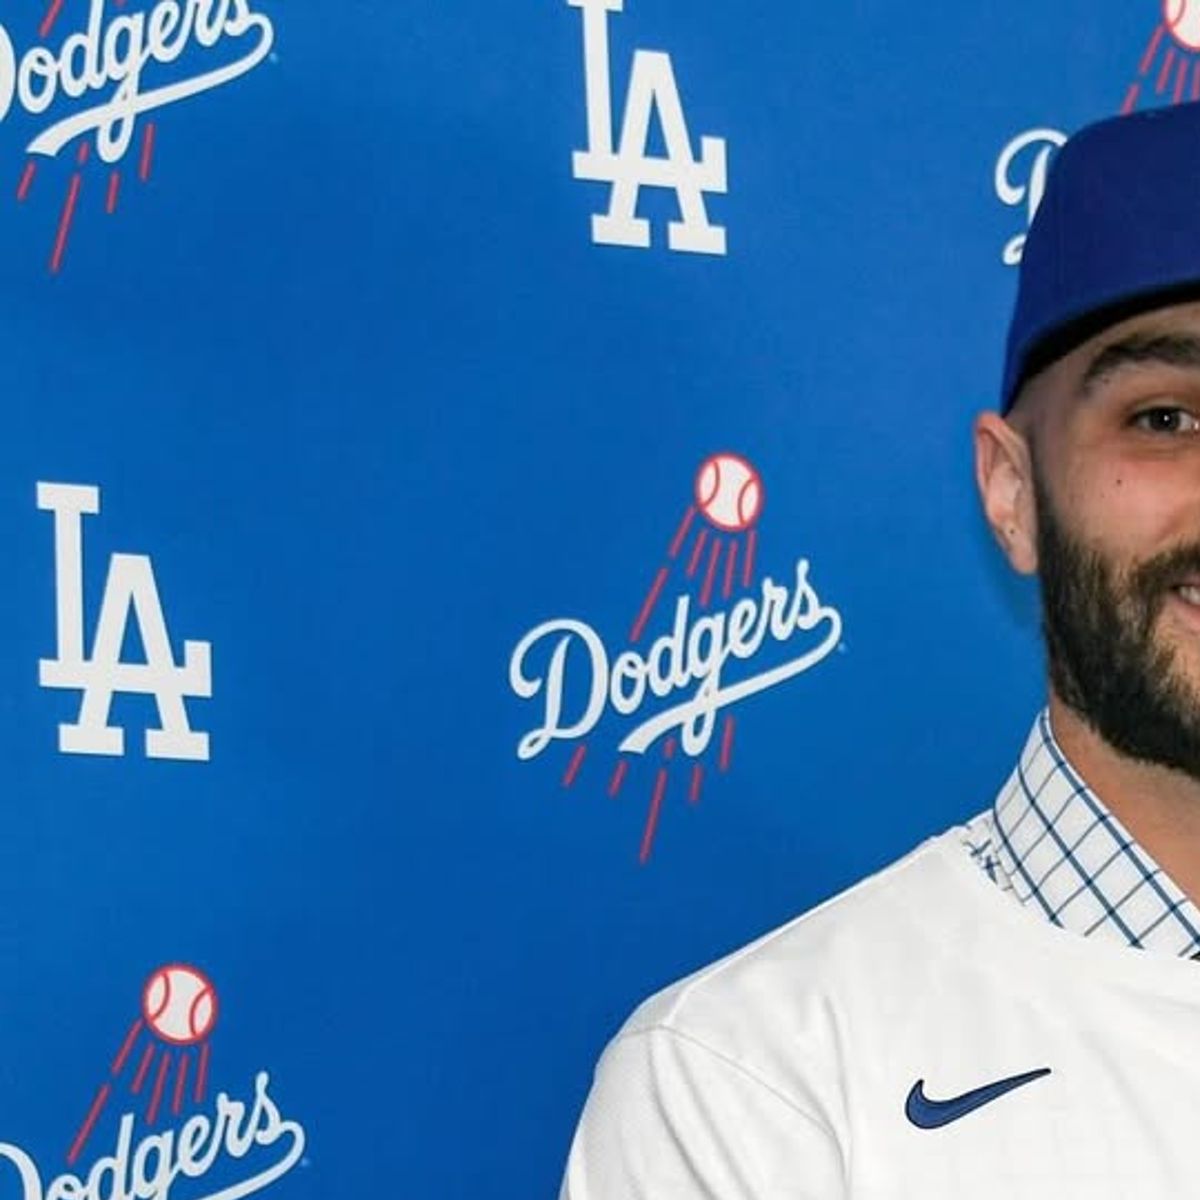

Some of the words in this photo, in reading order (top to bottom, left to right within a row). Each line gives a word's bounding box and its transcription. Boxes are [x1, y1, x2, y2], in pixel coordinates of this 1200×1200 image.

[0, 0, 274, 163] odgers
[567, 0, 728, 255] LA
[36, 481, 212, 761] LA
[509, 559, 843, 760] Dodgers
